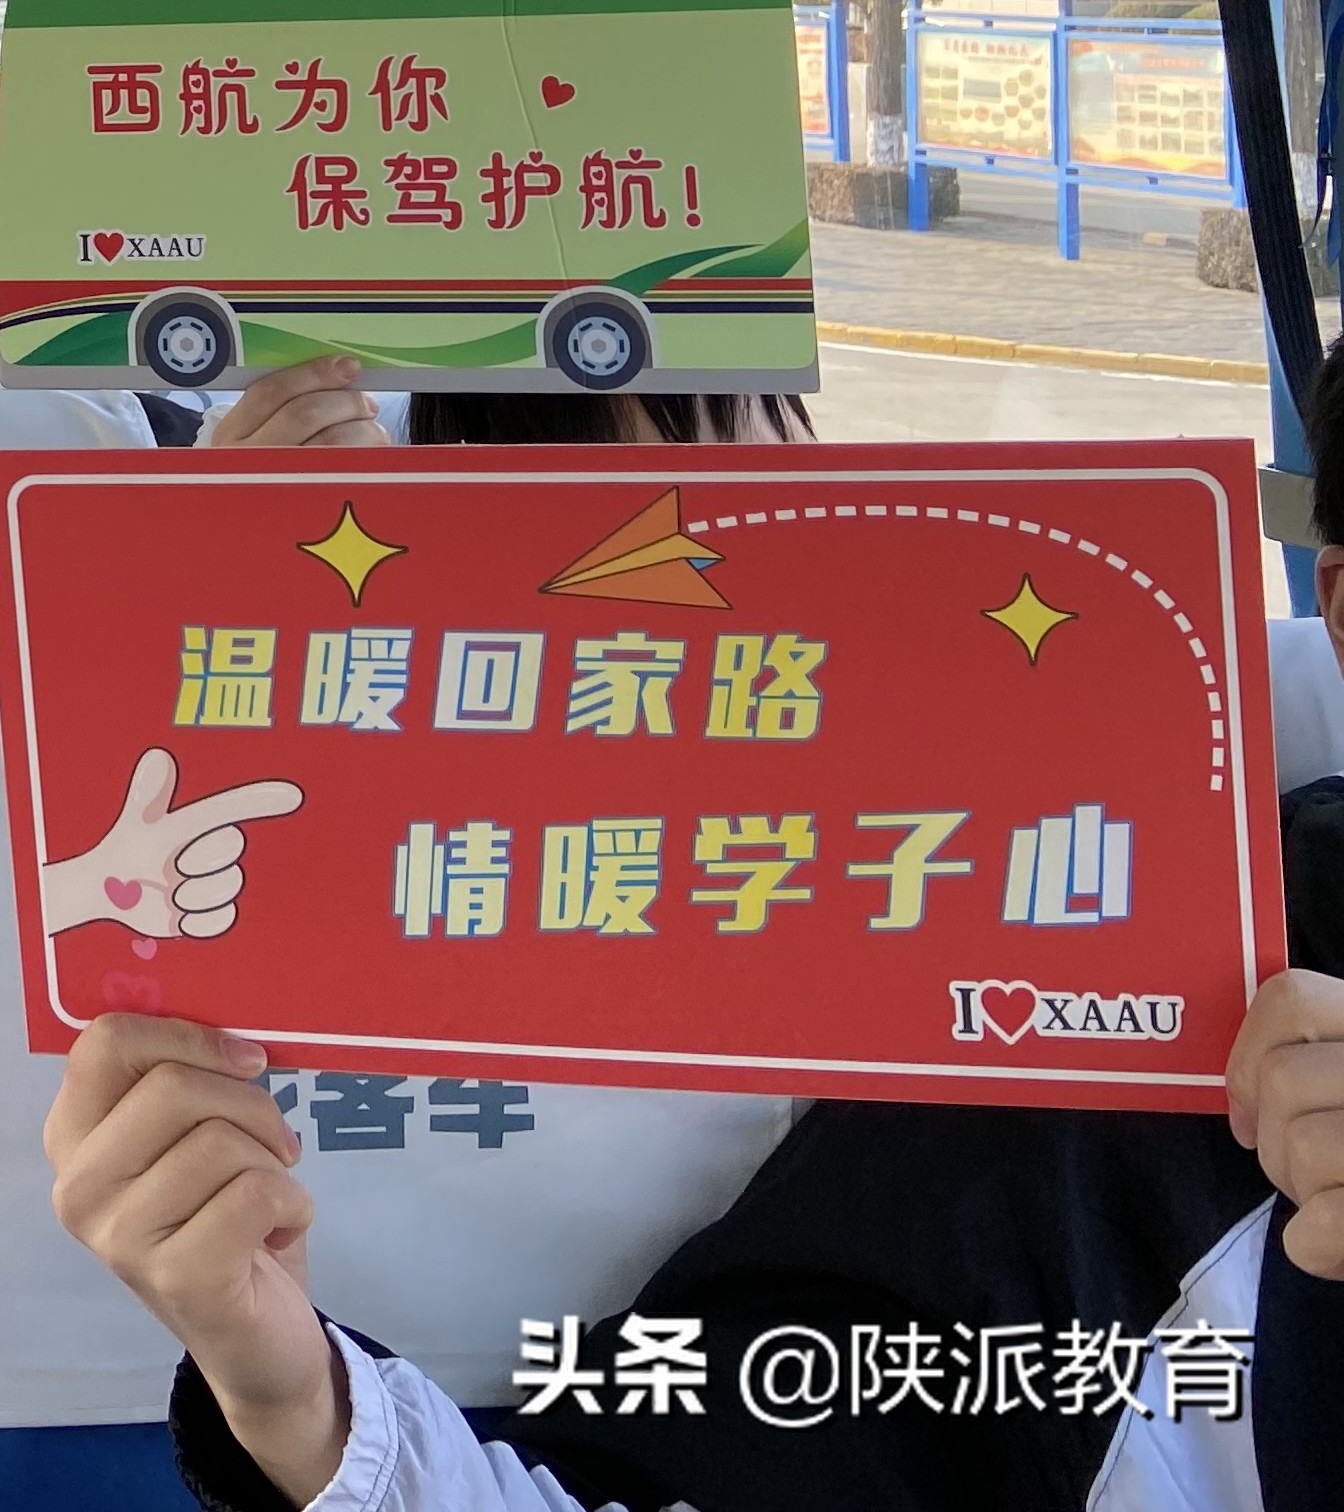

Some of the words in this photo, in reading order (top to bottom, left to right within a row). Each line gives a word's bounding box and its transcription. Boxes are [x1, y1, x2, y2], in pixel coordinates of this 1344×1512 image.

[86, 53, 450, 136] 西航为你
[284, 146, 704, 231] 保驾护航!
[80, 235, 92, 261] I
[127, 236, 205, 260] XAAU
[173, 625, 830, 742] 温暖回家路
[391, 802, 1135, 938] 情暖学子心
[954, 986, 976, 1038] I
[1040, 991, 1182, 1039] XAAU
